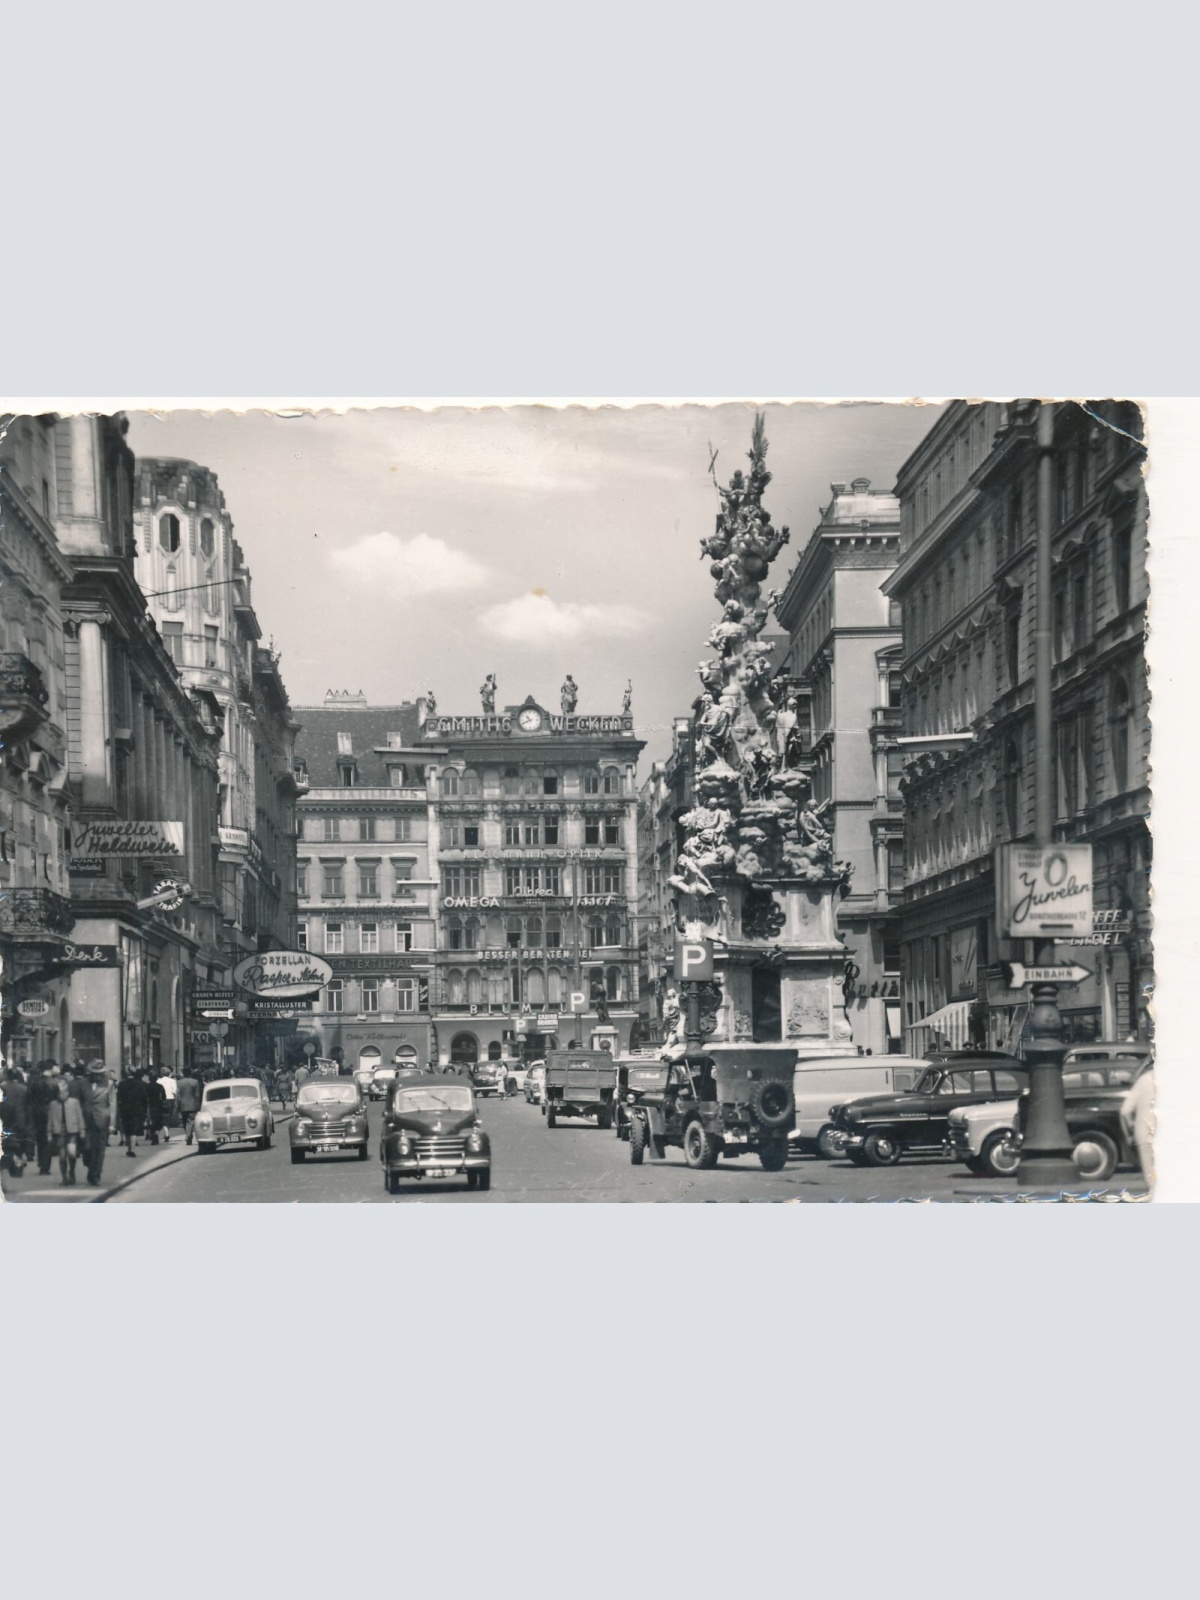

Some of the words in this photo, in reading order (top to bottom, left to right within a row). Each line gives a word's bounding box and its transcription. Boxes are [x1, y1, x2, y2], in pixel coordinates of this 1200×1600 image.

[438, 716, 512, 732] SMITHS
[549, 716, 621, 731] WECKER
[154, 880, 178, 894] TABAK
[159, 897, 184, 911] TRAFIK
[443, 896, 500, 908] OMEGA
[255, 955, 311, 965] PORZELLAN
[477, 950, 518, 960] BESSER
[681, 945, 707, 977] P
[1024, 968, 1073, 980] EINBAHN
[254, 1001, 307, 1009] KRISTALLUSTER
[570, 992, 586, 1012] P
[515, 1019, 526, 1032] P
